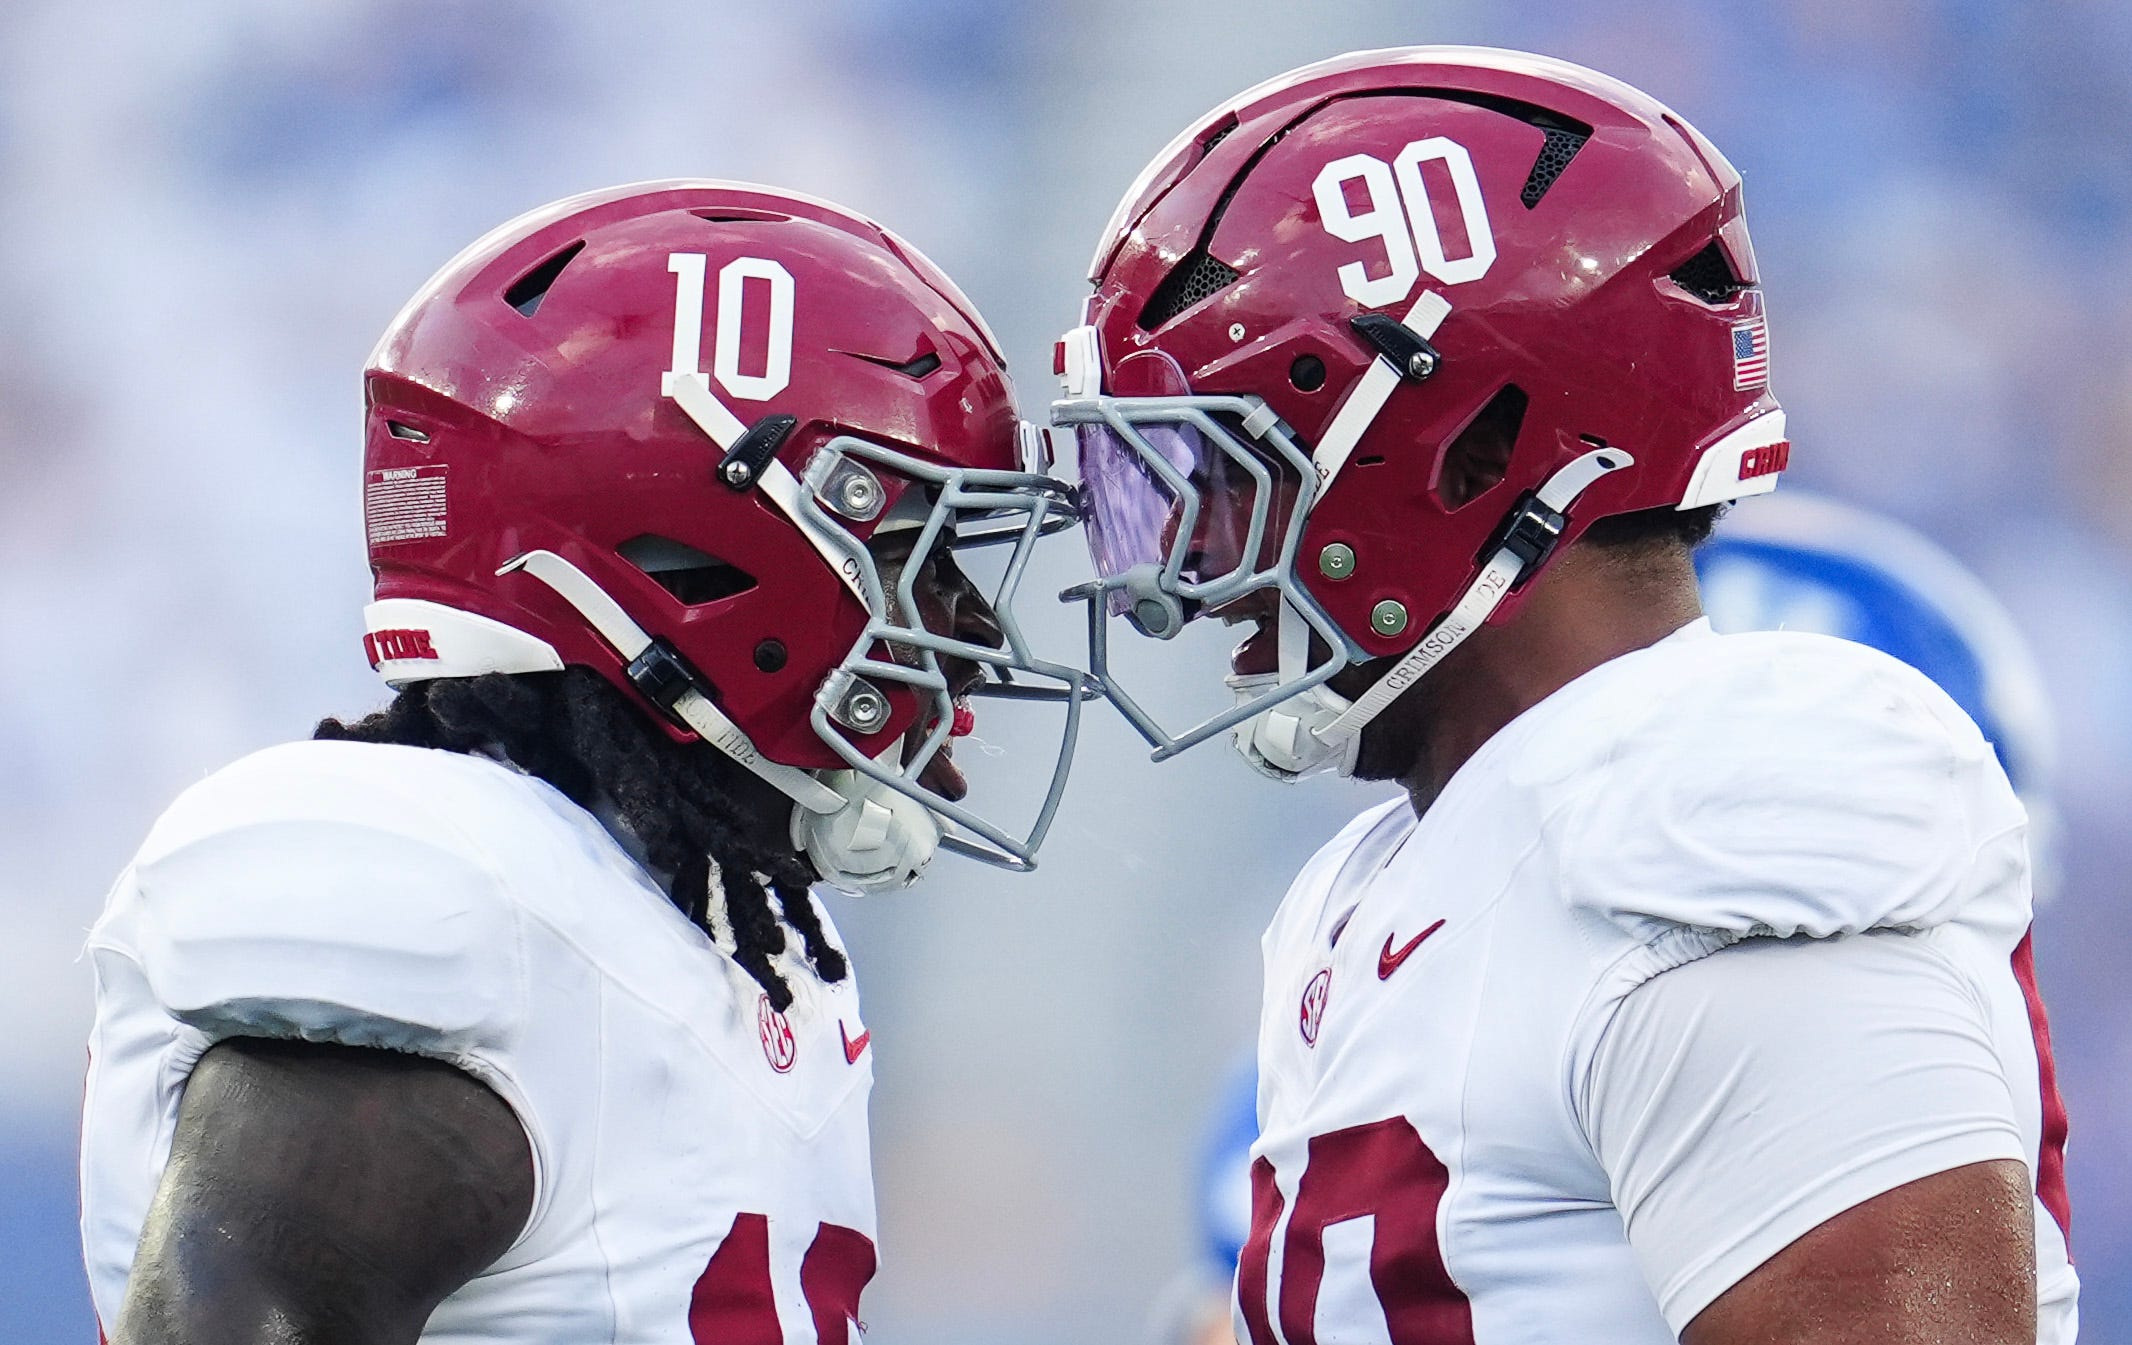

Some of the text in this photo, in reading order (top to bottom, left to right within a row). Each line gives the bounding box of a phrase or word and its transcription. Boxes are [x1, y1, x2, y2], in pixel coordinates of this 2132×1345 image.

[1311, 135, 1498, 310] 90
[660, 252, 797, 402] 10
[382, 469, 418, 481] WARNING
[375, 629, 439, 660] TIDE
[1386, 618, 1466, 690] CRIMSON
